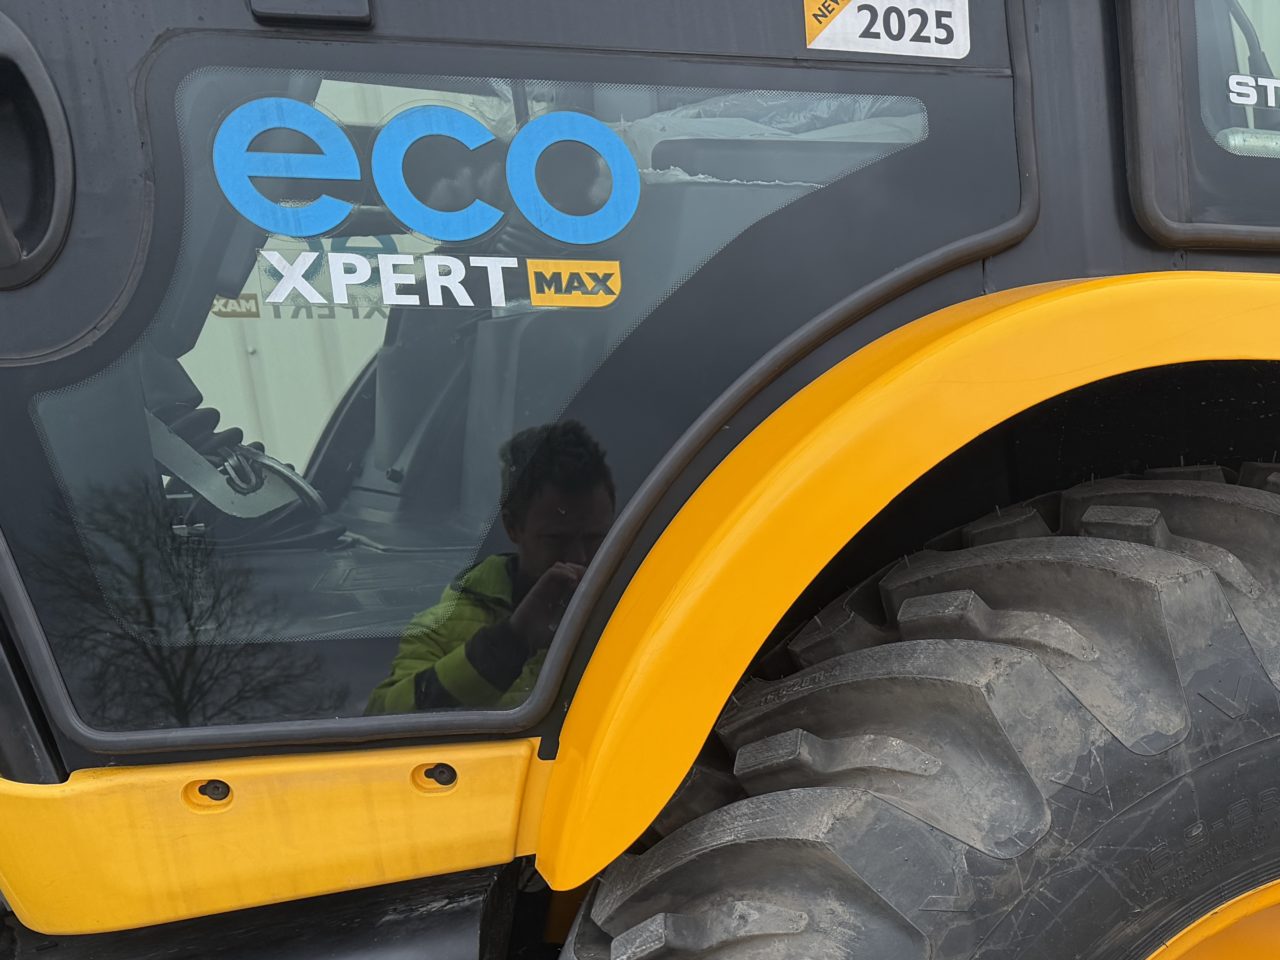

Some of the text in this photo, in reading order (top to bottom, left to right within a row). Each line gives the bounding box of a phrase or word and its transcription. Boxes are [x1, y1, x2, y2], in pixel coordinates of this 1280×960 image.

[857, 3, 954, 46] 2025
[212, 97, 641, 245] eco
[259, 249, 518, 307] XPERT
[534, 271, 617, 296] MAX
